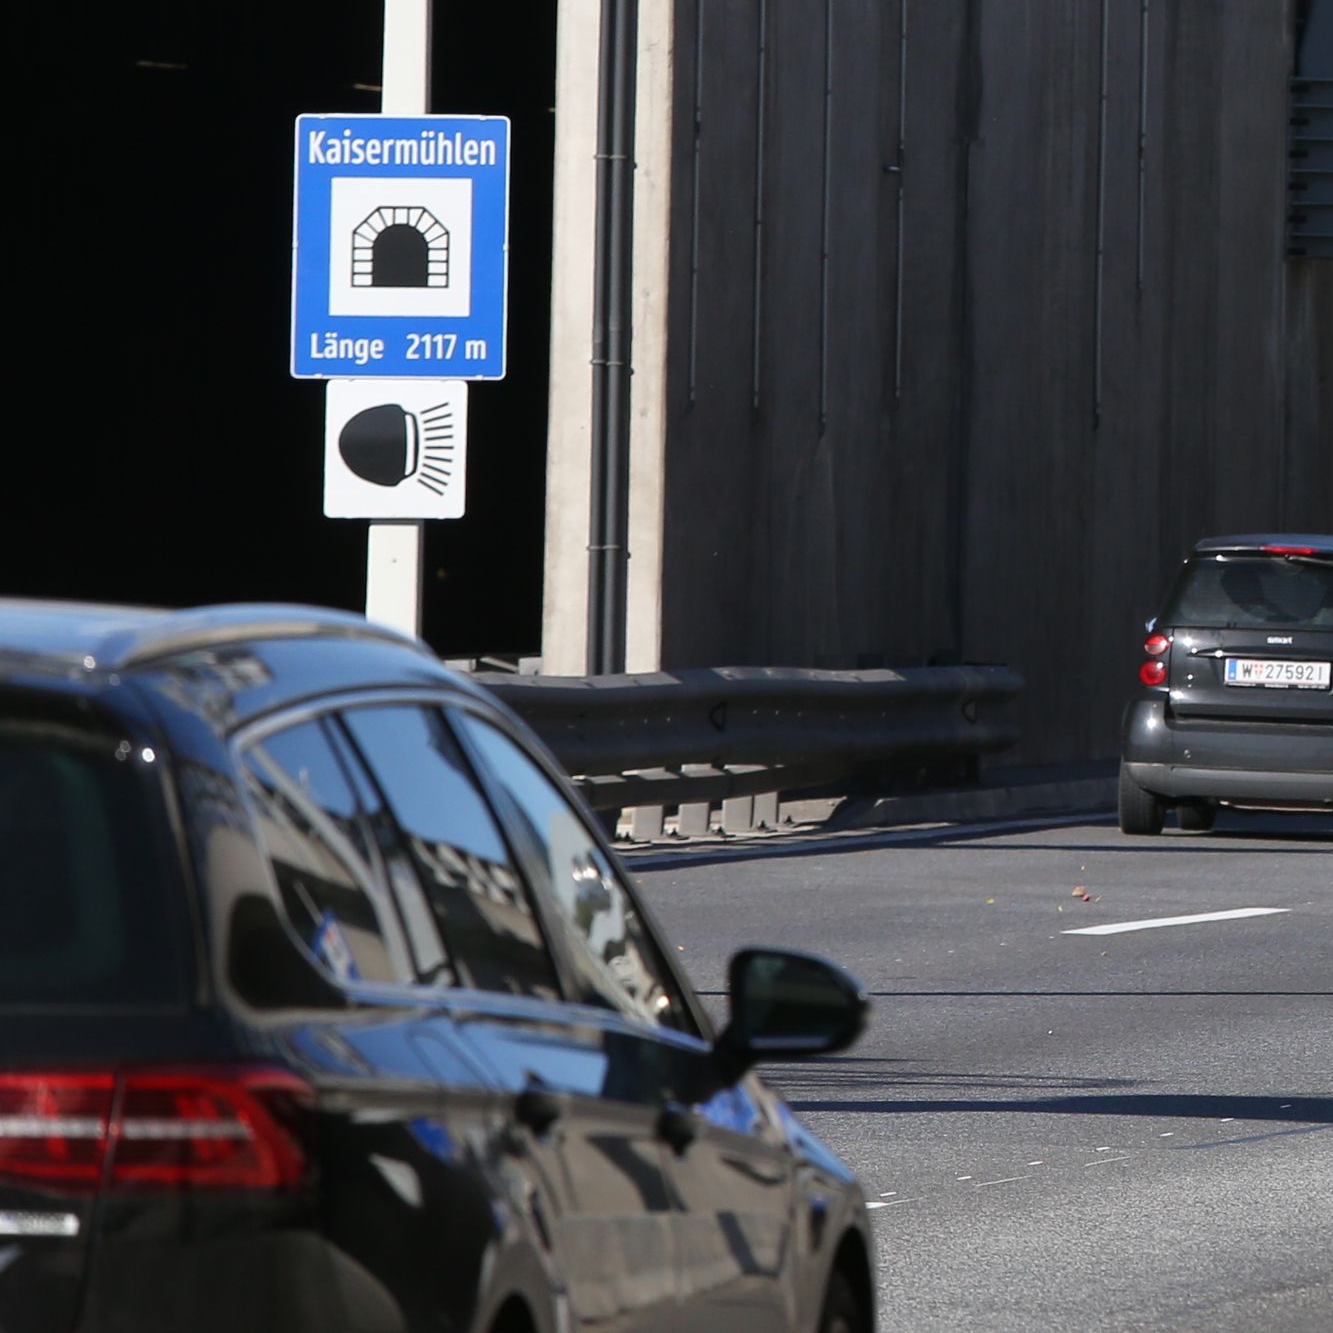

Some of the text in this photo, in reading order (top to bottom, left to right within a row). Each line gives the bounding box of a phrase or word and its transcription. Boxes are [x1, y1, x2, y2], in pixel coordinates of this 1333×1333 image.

[308, 129, 496, 166] Kaisermühlen
[310, 332, 487, 365] Länge 2117 m
[1242, 664, 1253, 678] W
